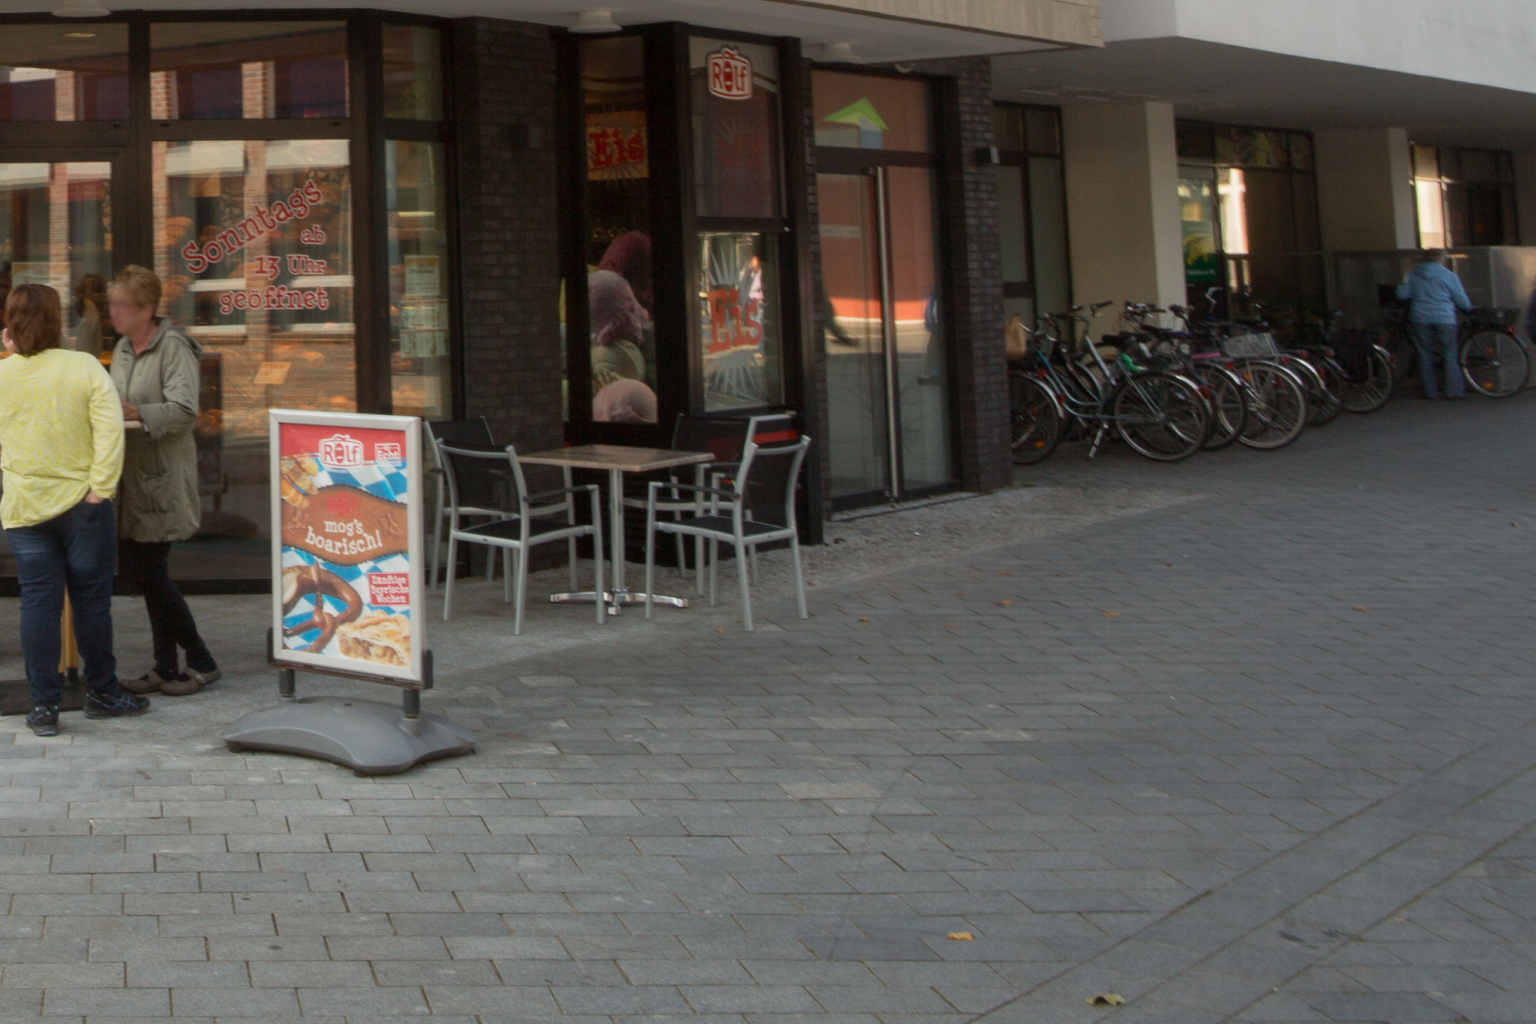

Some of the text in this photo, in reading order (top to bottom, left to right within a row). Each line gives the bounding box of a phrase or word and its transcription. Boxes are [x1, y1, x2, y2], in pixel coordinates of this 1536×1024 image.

[589, 128, 646, 166] Eis
[182, 180, 322, 273] Sonntags
[301, 225, 326, 244] ab
[254, 255, 326, 280] 13 Uhr
[219, 286, 329, 315] geöffnet
[707, 288, 762, 354] Eis
[305, 526, 383, 556] boarisch!
[324, 518, 364, 537] mog's
[375, 593, 407, 603] Wochen
